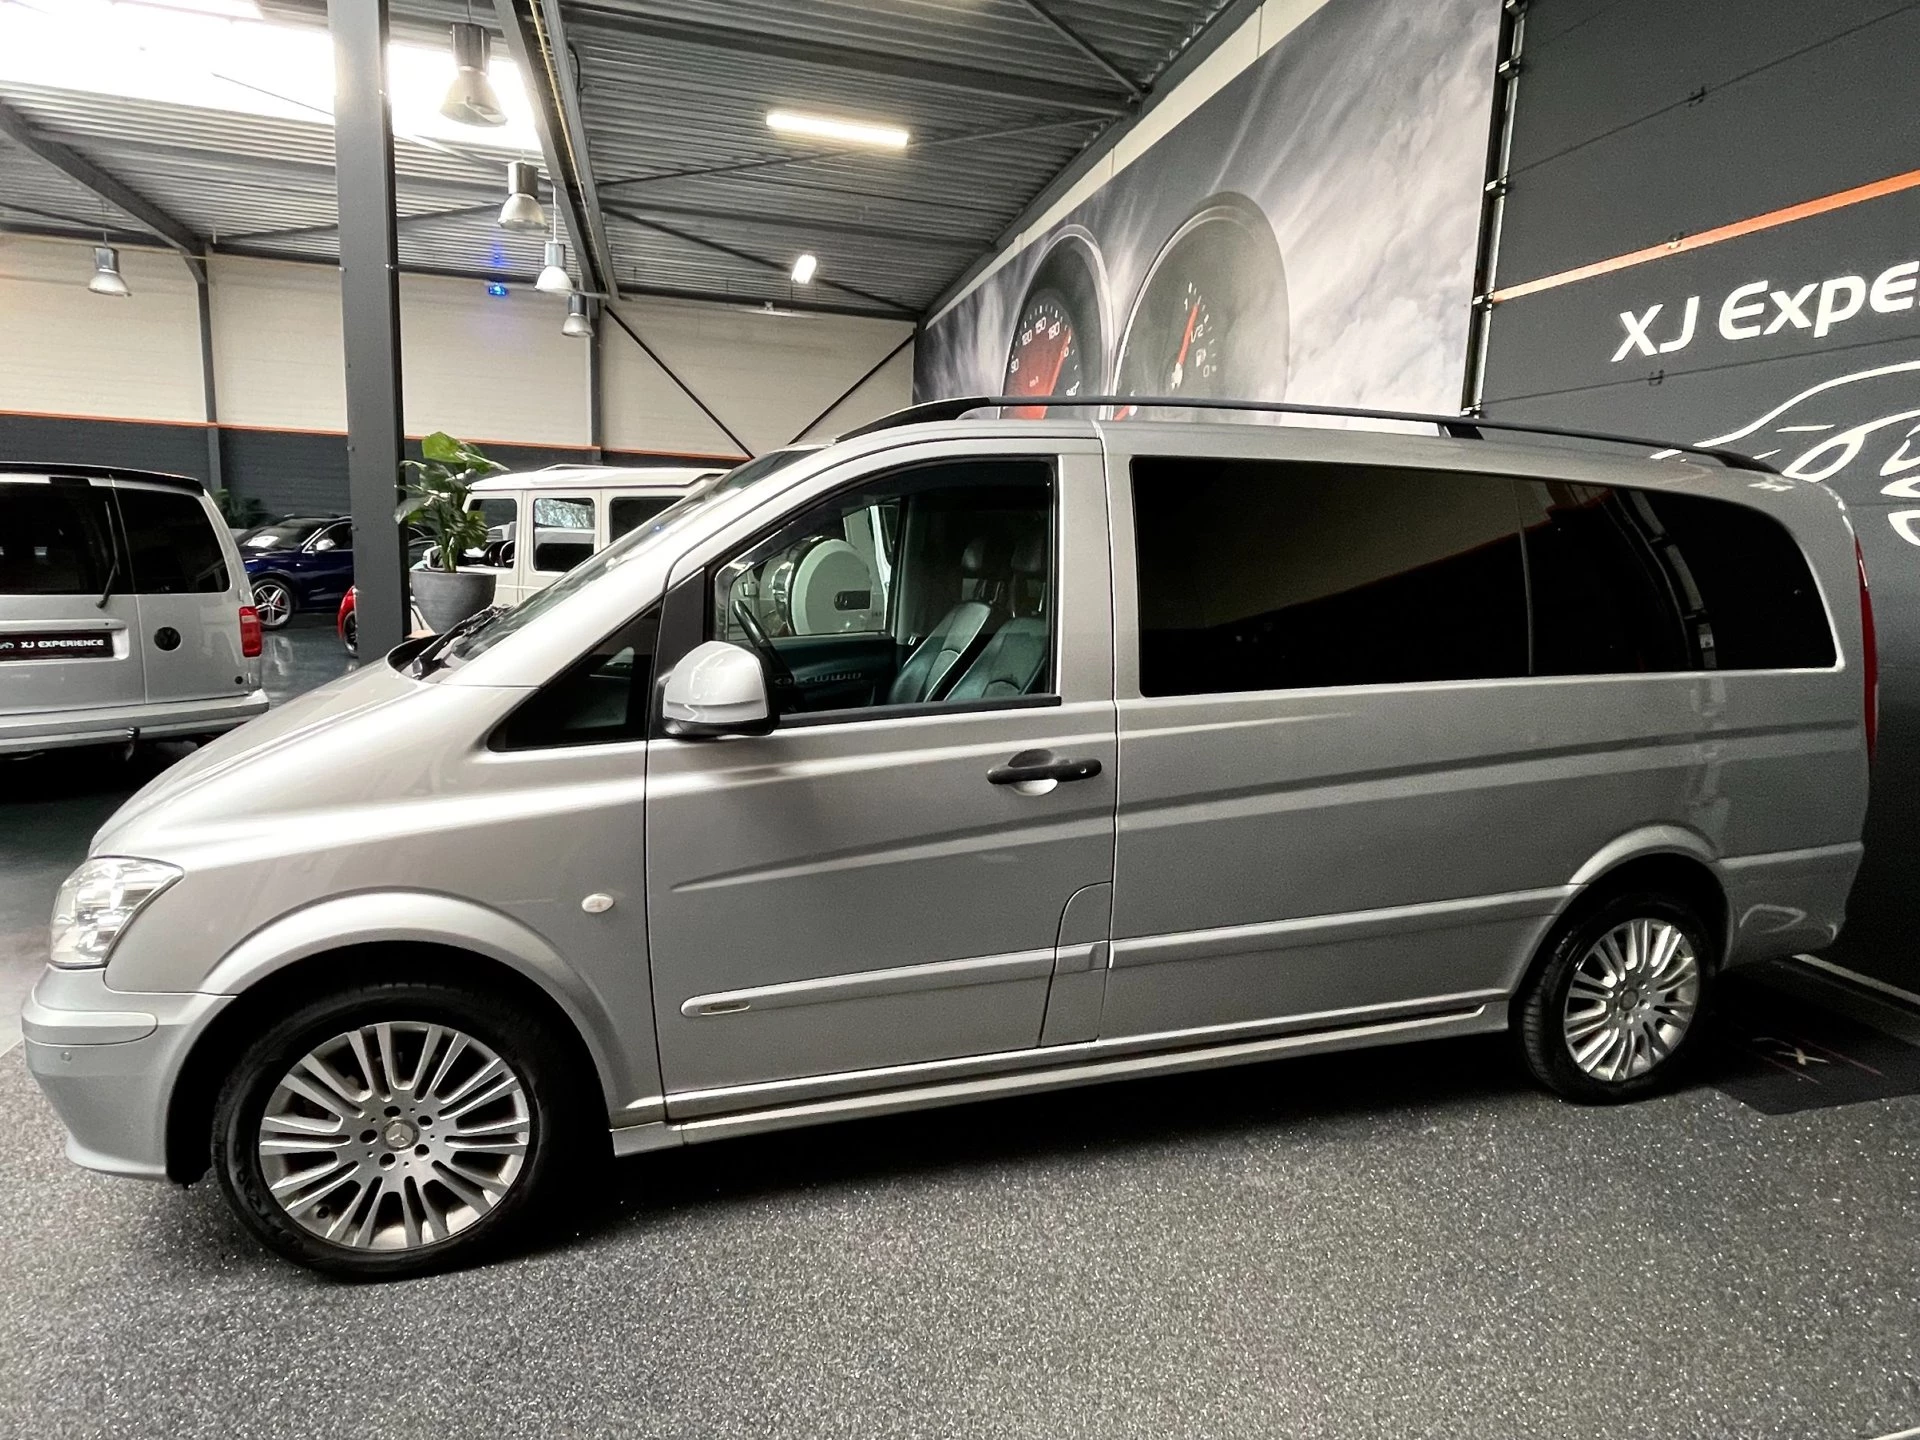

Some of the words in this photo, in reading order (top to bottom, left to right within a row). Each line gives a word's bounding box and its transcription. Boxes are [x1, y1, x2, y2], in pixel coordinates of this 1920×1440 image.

[1610, 295, 1700, 362] XJ
[21, 641, 35, 649] XJ
[38, 639, 104, 648] EXPERIENCE
